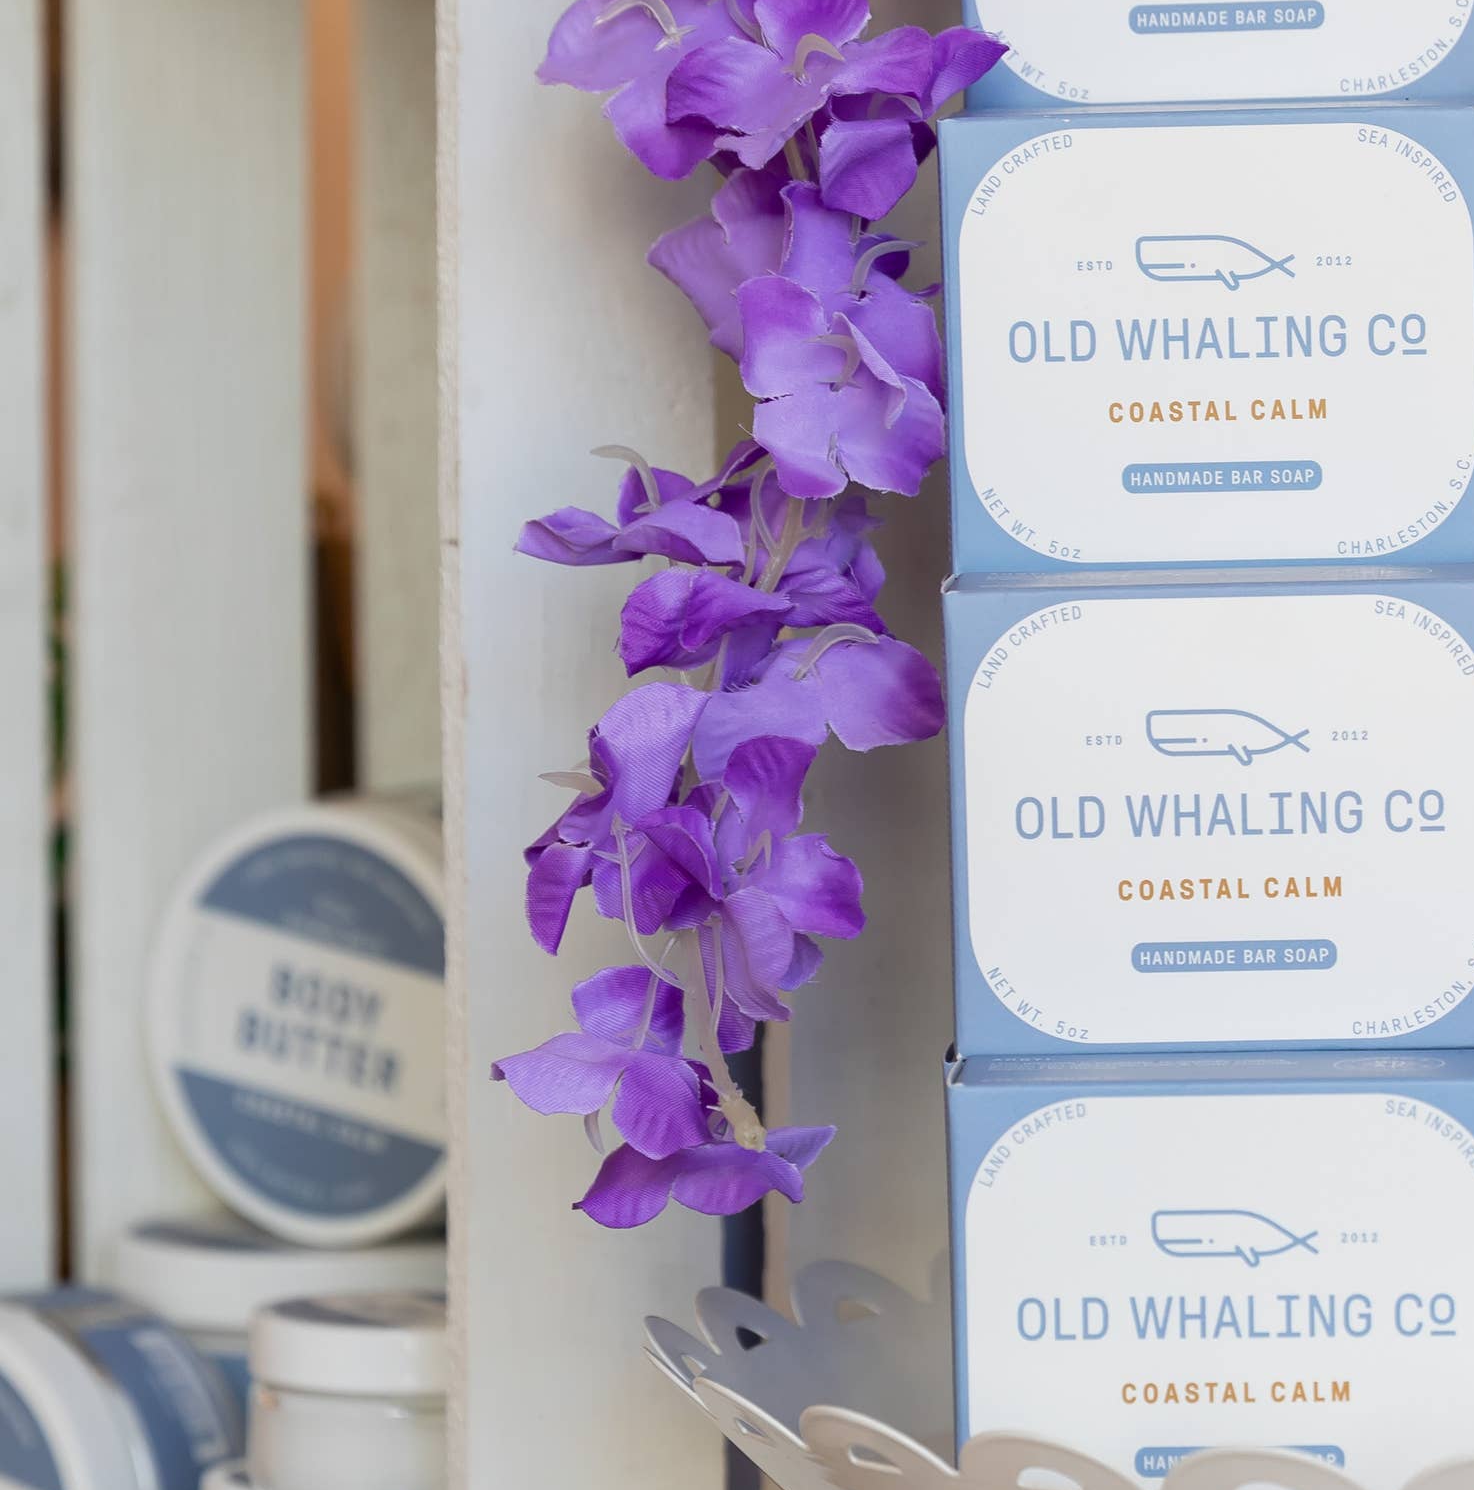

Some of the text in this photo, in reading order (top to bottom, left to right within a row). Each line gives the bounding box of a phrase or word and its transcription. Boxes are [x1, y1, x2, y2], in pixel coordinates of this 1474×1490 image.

[1137, 8, 1317, 28] HANDMADE BAR SOAP
[971, 133, 1073, 216] LAND CRAFTED
[1358, 128, 1457, 205] SEA INSPIRED
[1077, 256, 1353, 271] ESTD 2012
[1008, 320, 1096, 363] OLD
[1116, 314, 1347, 361] WHALING
[1108, 398, 1328, 423] COASTAL CALM
[1130, 468, 1315, 487] HANDMADE BAR SOAP
[1085, 730, 1369, 746] ESTD 2012
[1015, 796, 1105, 840] OLD
[1126, 789, 1363, 838] WHALING
[1118, 876, 1343, 901] COASTAL CALM
[1140, 947, 1329, 965] HANDMADE BAR SOAP
[271, 961, 384, 1030] BODY
[237, 1006, 403, 1094] BUTTER
[1017, 1296, 1109, 1341] OLD
[1130, 1294, 1373, 1340] WHALING
[1122, 1381, 1351, 1404] COASTAL CALM
